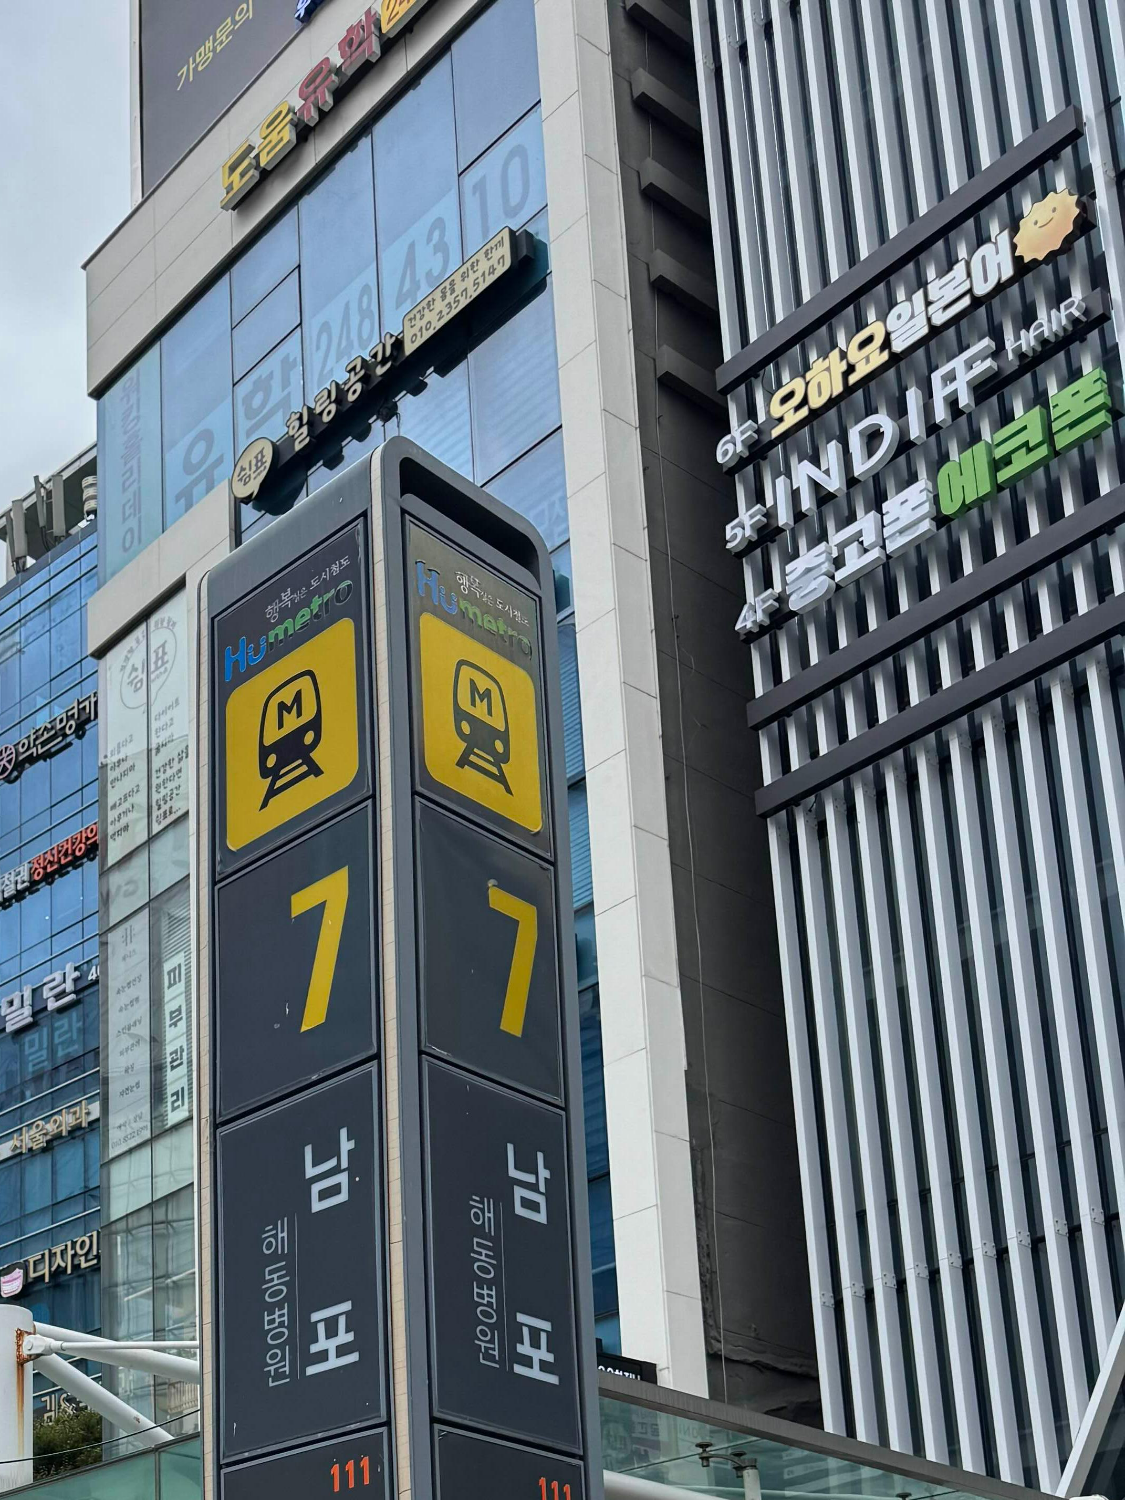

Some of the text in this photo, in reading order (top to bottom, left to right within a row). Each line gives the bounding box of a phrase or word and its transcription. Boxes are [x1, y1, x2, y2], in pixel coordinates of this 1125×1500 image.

[407, 297, 436, 329] 건강한
[460, 258, 480, 283] 위한
[410, 254, 506, 344] 010.2357.5147
[236, 332, 399, 487] 쉼표 힐링공간
[725, 504, 767, 554] 5F
[1007, 296, 1088, 361] HAIR
[310, 556, 351, 591] 도시철도
[415, 559, 534, 660] Humetro
[734, 589, 779, 638] 4F
[126, 640, 169, 694] 쉼표
[225, 580, 353, 681] Humetro
[1, 962, 81, 1033] 밀란
[290, 866, 349, 1033] 7
[488, 885, 537, 1038] 7
[167, 963, 185, 1113] 피부관리
[10, 1100, 91, 1153] 서울외과
[261, 1216, 291, 1387] 해동병원
[304, 1127, 360, 1376] 남포
[469, 1195, 501, 1369] 해동병원
[507, 1142, 560, 1386] 남포
[330, 1456, 371, 1492] 111
